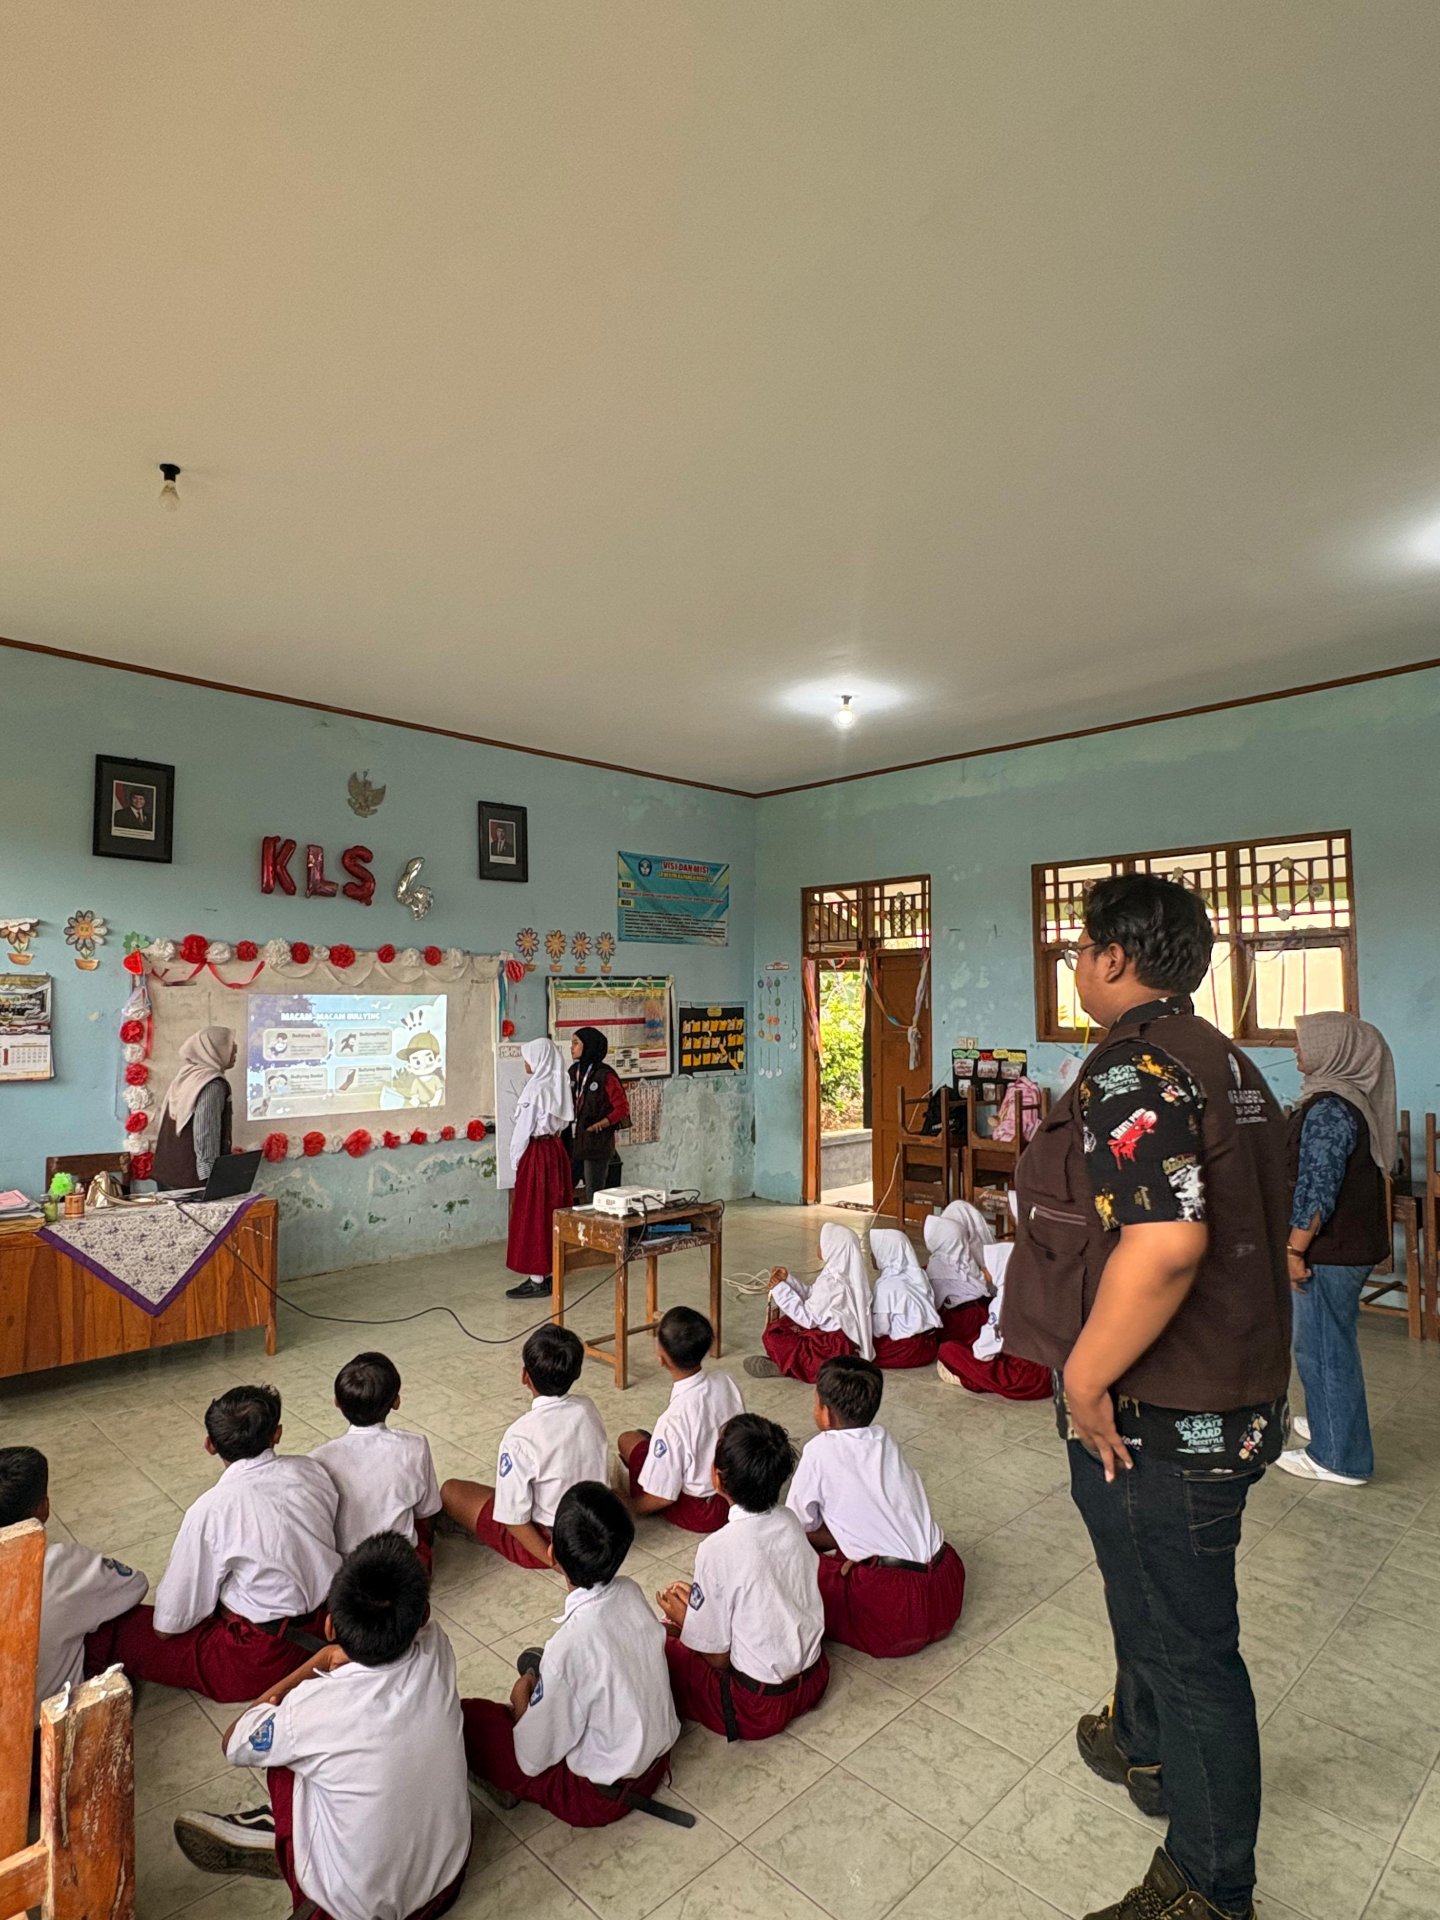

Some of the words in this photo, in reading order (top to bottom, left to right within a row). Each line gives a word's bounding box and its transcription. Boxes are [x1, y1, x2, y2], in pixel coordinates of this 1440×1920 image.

[261, 835, 376, 905] KLS
[663, 861, 678, 871] VISI
[678, 863, 693, 872] DAN
[693, 865, 710, 874] MISI
[1191, 1418, 1223, 1431] SKATE
[1179, 1427, 1222, 1441] BOARD
